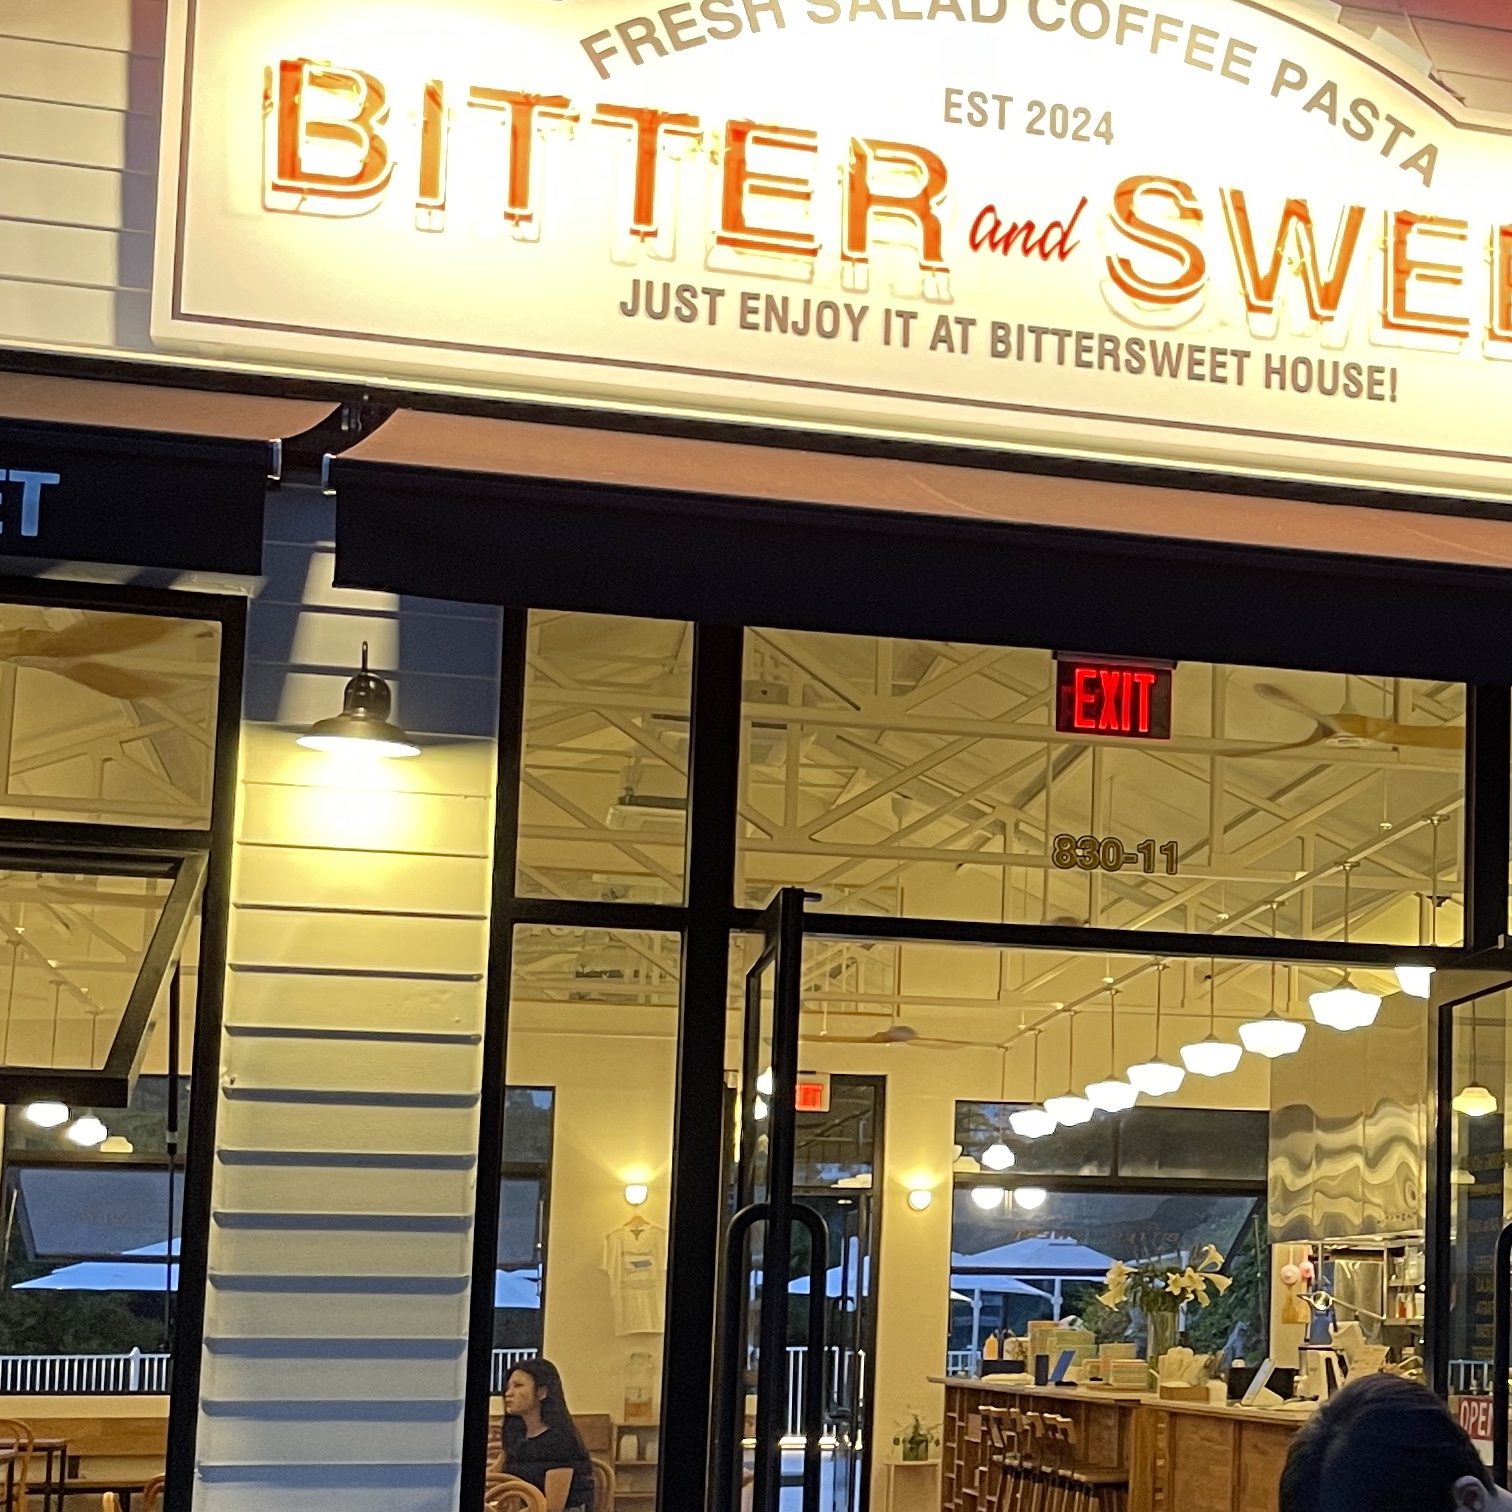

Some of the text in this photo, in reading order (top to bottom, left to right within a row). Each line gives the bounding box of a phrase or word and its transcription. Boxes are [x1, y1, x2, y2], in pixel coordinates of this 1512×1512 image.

[580, 0, 787, 81] FRESH
[1028, 0, 1258, 86] COFFEE
[1270, 58, 1440, 188] PASTA
[943, 87, 1115, 146] EST 2024
[262, 57, 950, 288] BITTER
[968, 196, 1088, 263] and
[619, 278, 1399, 404] JUST ENJOY IT AT BITTERSWEET HOUSE!
[1073, 668, 1157, 733] EXIT
[1051, 833, 1179, 876] 830-11
